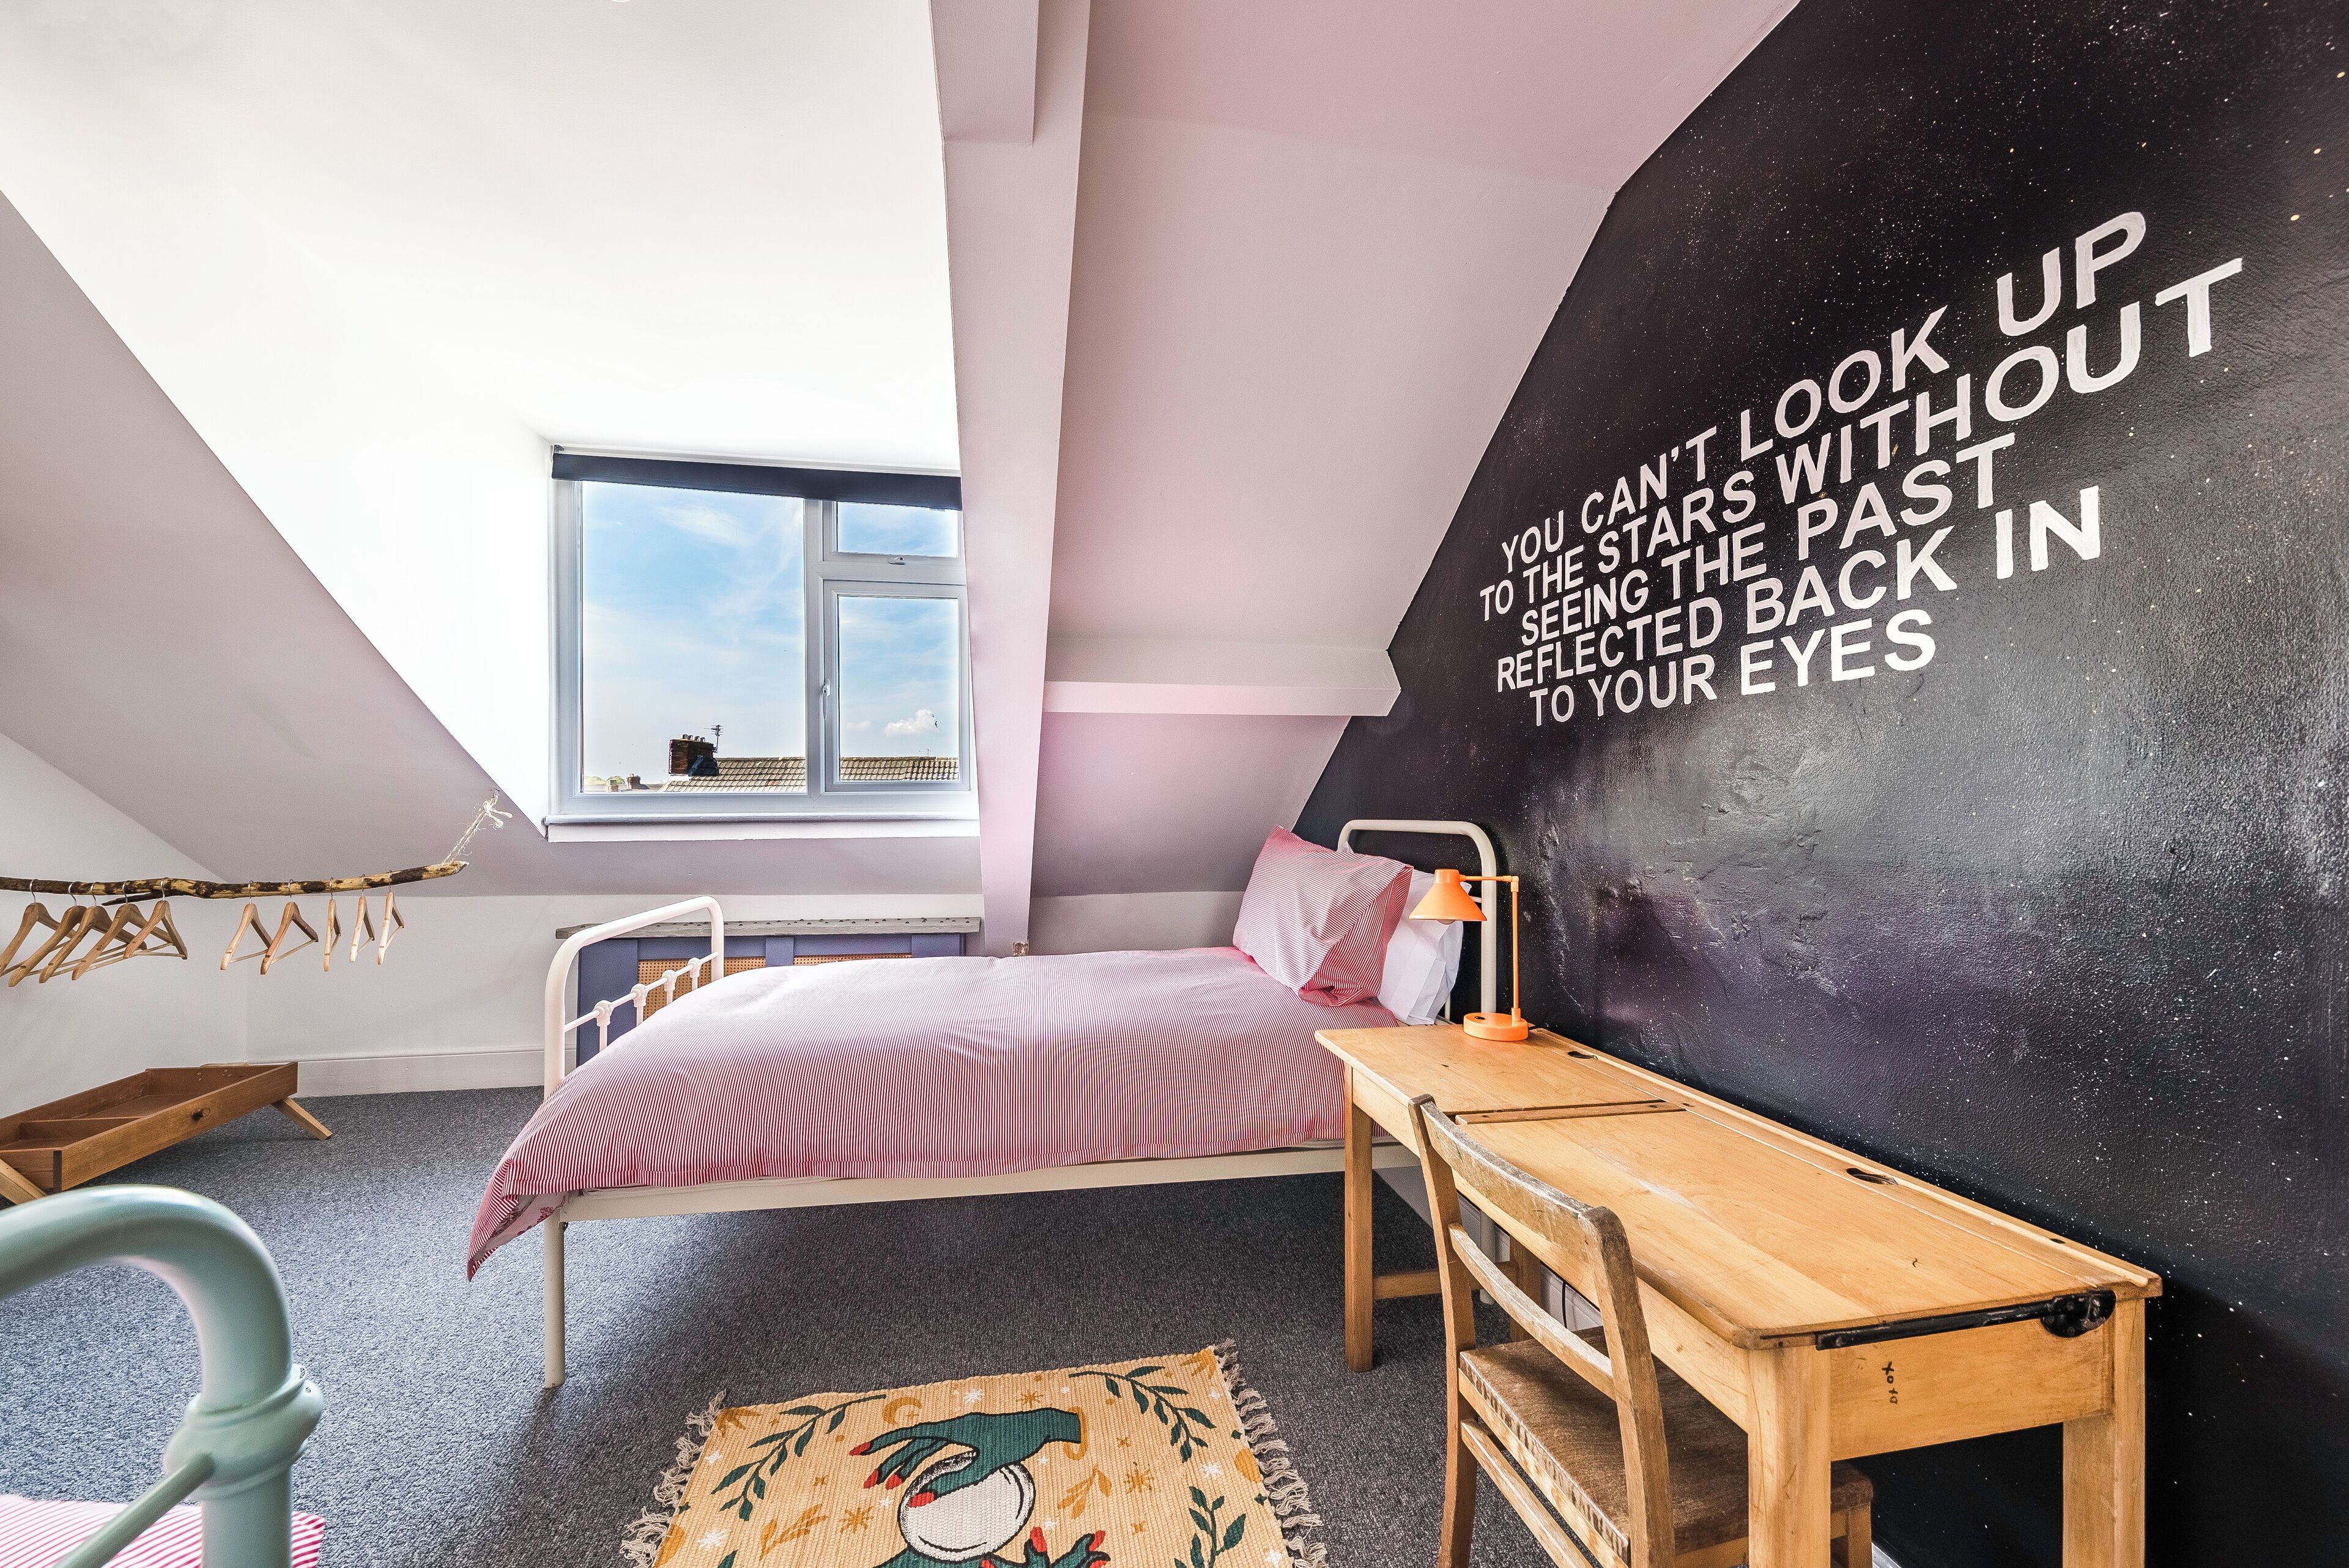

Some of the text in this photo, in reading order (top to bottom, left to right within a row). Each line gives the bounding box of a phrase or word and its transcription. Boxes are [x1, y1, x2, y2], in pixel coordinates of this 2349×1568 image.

[1480, 258, 2243, 622] TO THE STARS WITHOUT
[1502, 510, 1564, 573] YOU
[1741, 305, 1949, 463] LOOK
[1997, 212, 2146, 336] UP
[1497, 485, 2101, 693] REFLECTED BACK IN
[1522, 433, 2015, 646] SEEING THE PAST
[1530, 609, 1937, 727] TO YOUR EYES
